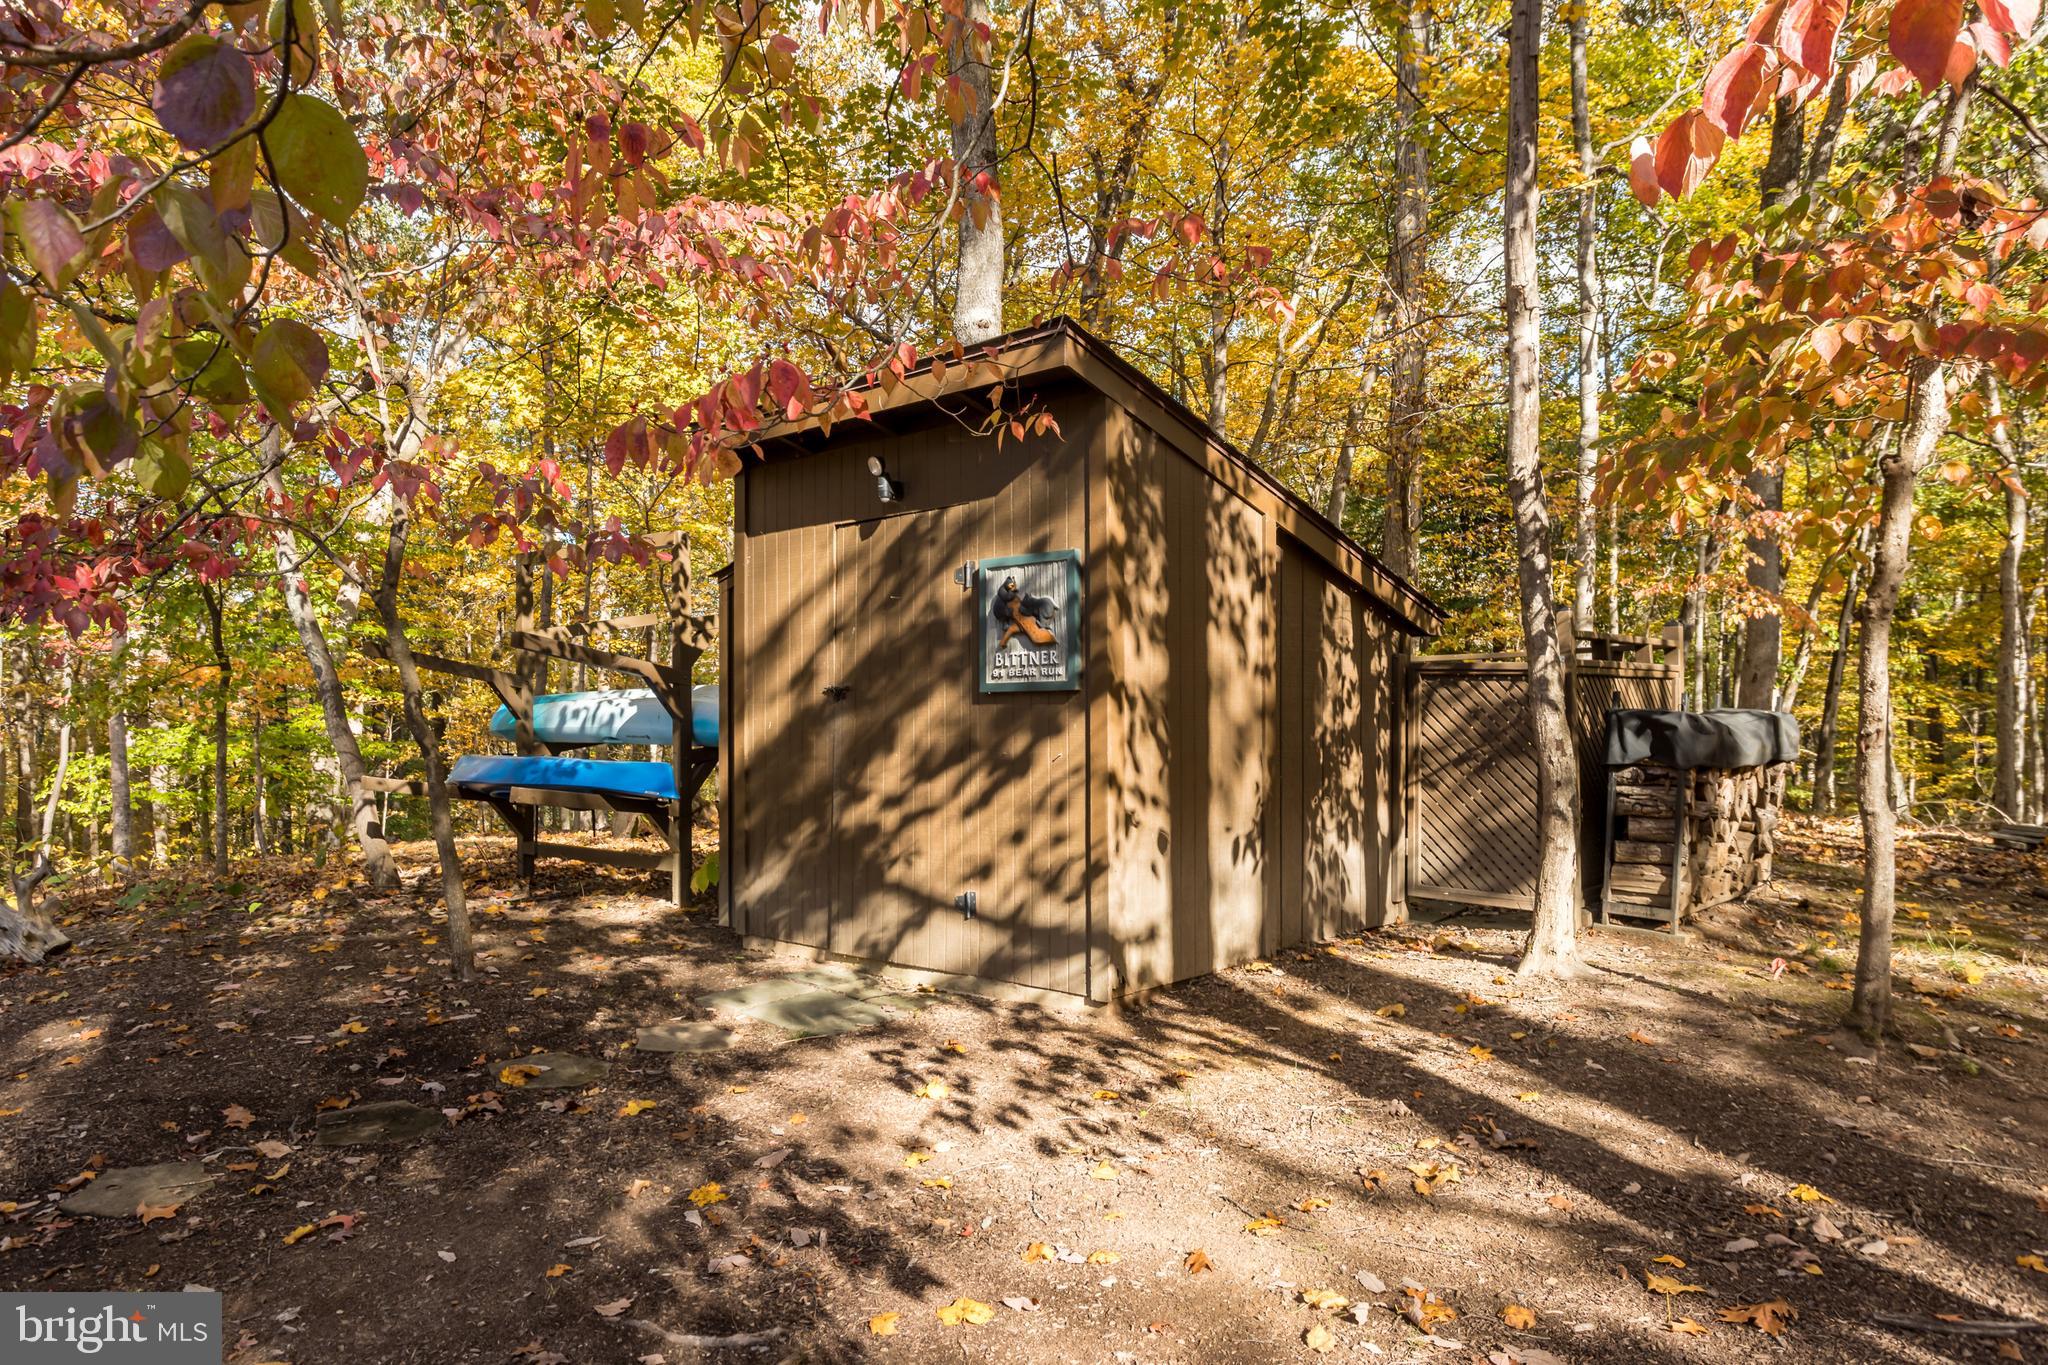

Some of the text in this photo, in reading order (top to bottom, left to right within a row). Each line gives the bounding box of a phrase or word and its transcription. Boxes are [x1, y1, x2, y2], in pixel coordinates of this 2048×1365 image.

[995, 650, 1058, 667] BITTNER
[1008, 668, 1036, 677] BEAR
[1041, 667, 1064, 676] RUN
